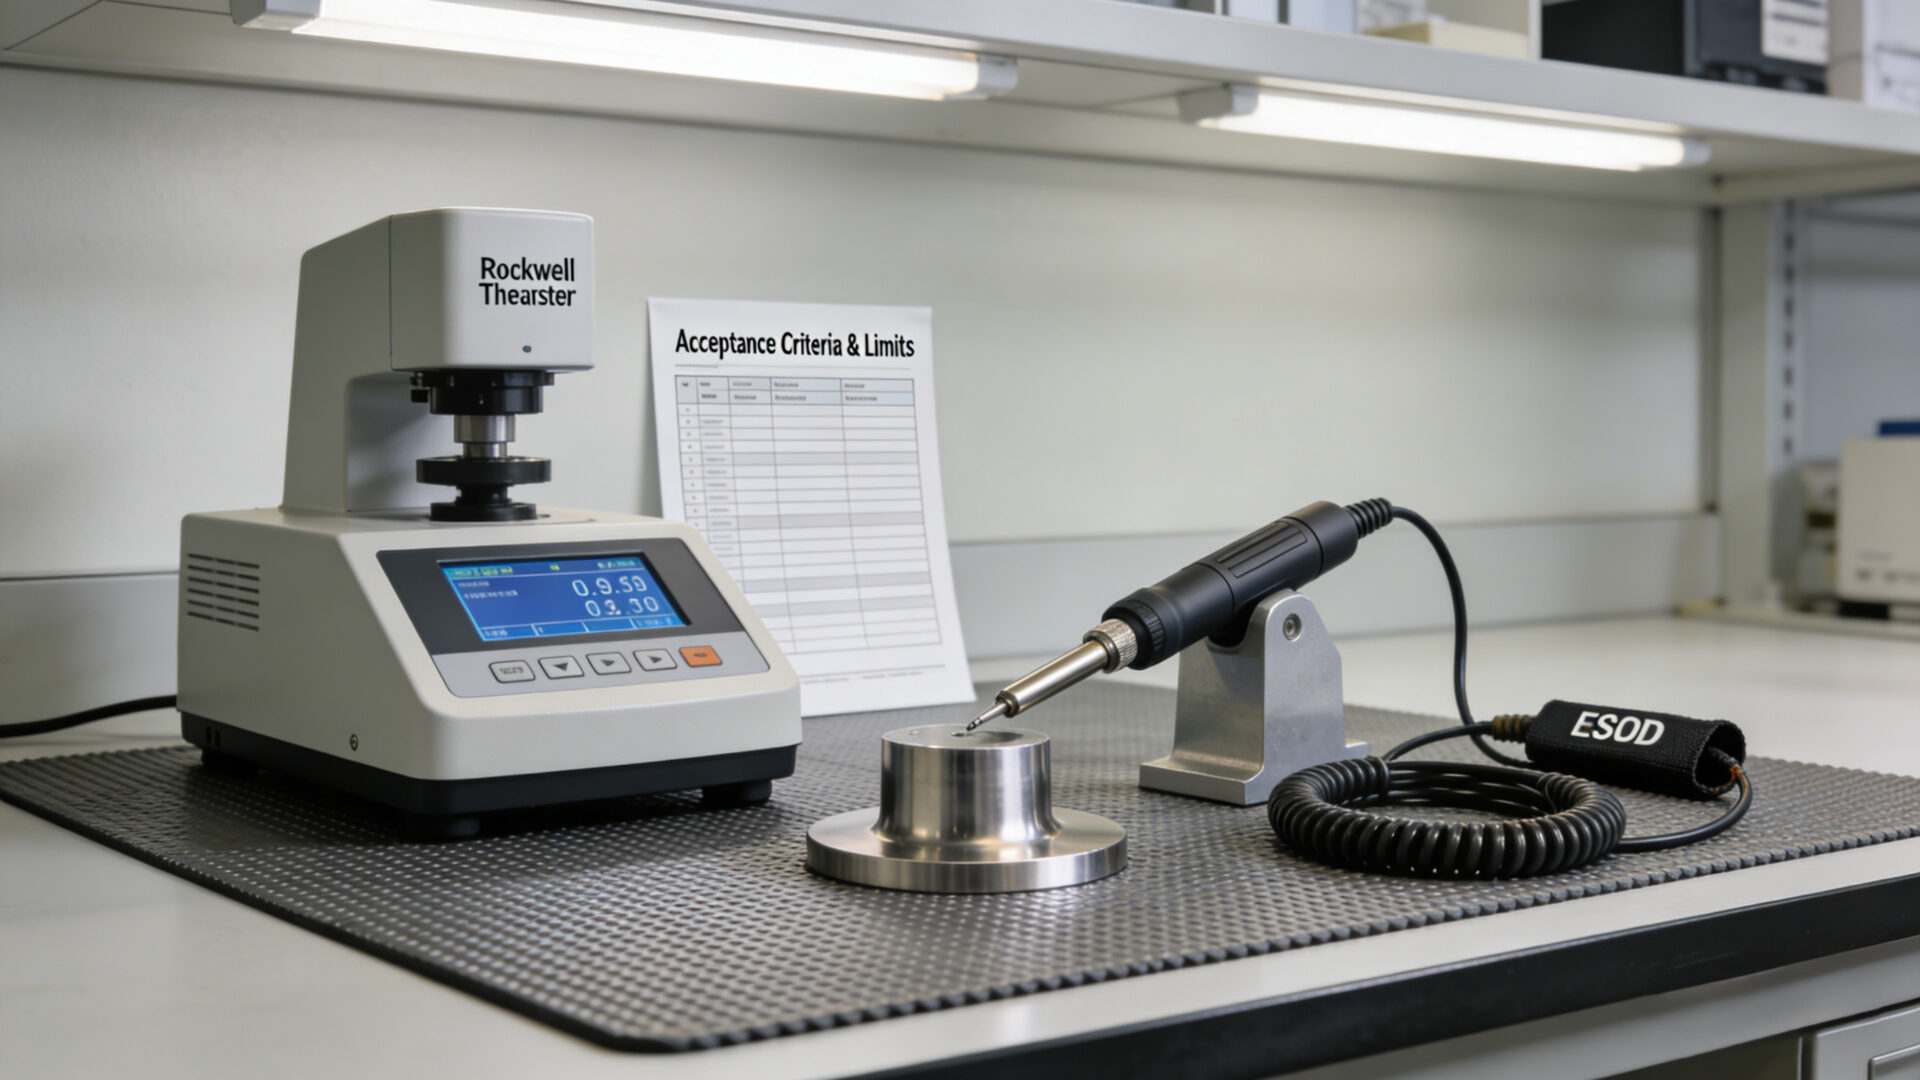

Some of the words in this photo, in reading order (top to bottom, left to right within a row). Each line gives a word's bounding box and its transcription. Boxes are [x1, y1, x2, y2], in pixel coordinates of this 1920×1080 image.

[481, 257, 575, 281] Rockwell
[479, 282, 576, 306] Thearster
[675, 328, 776, 360] Acceptance
[781, 331, 842, 356] Criteria
[847, 333, 860, 356] &
[865, 333, 915, 357] Limits
[1571, 711, 1665, 746] ESOD
